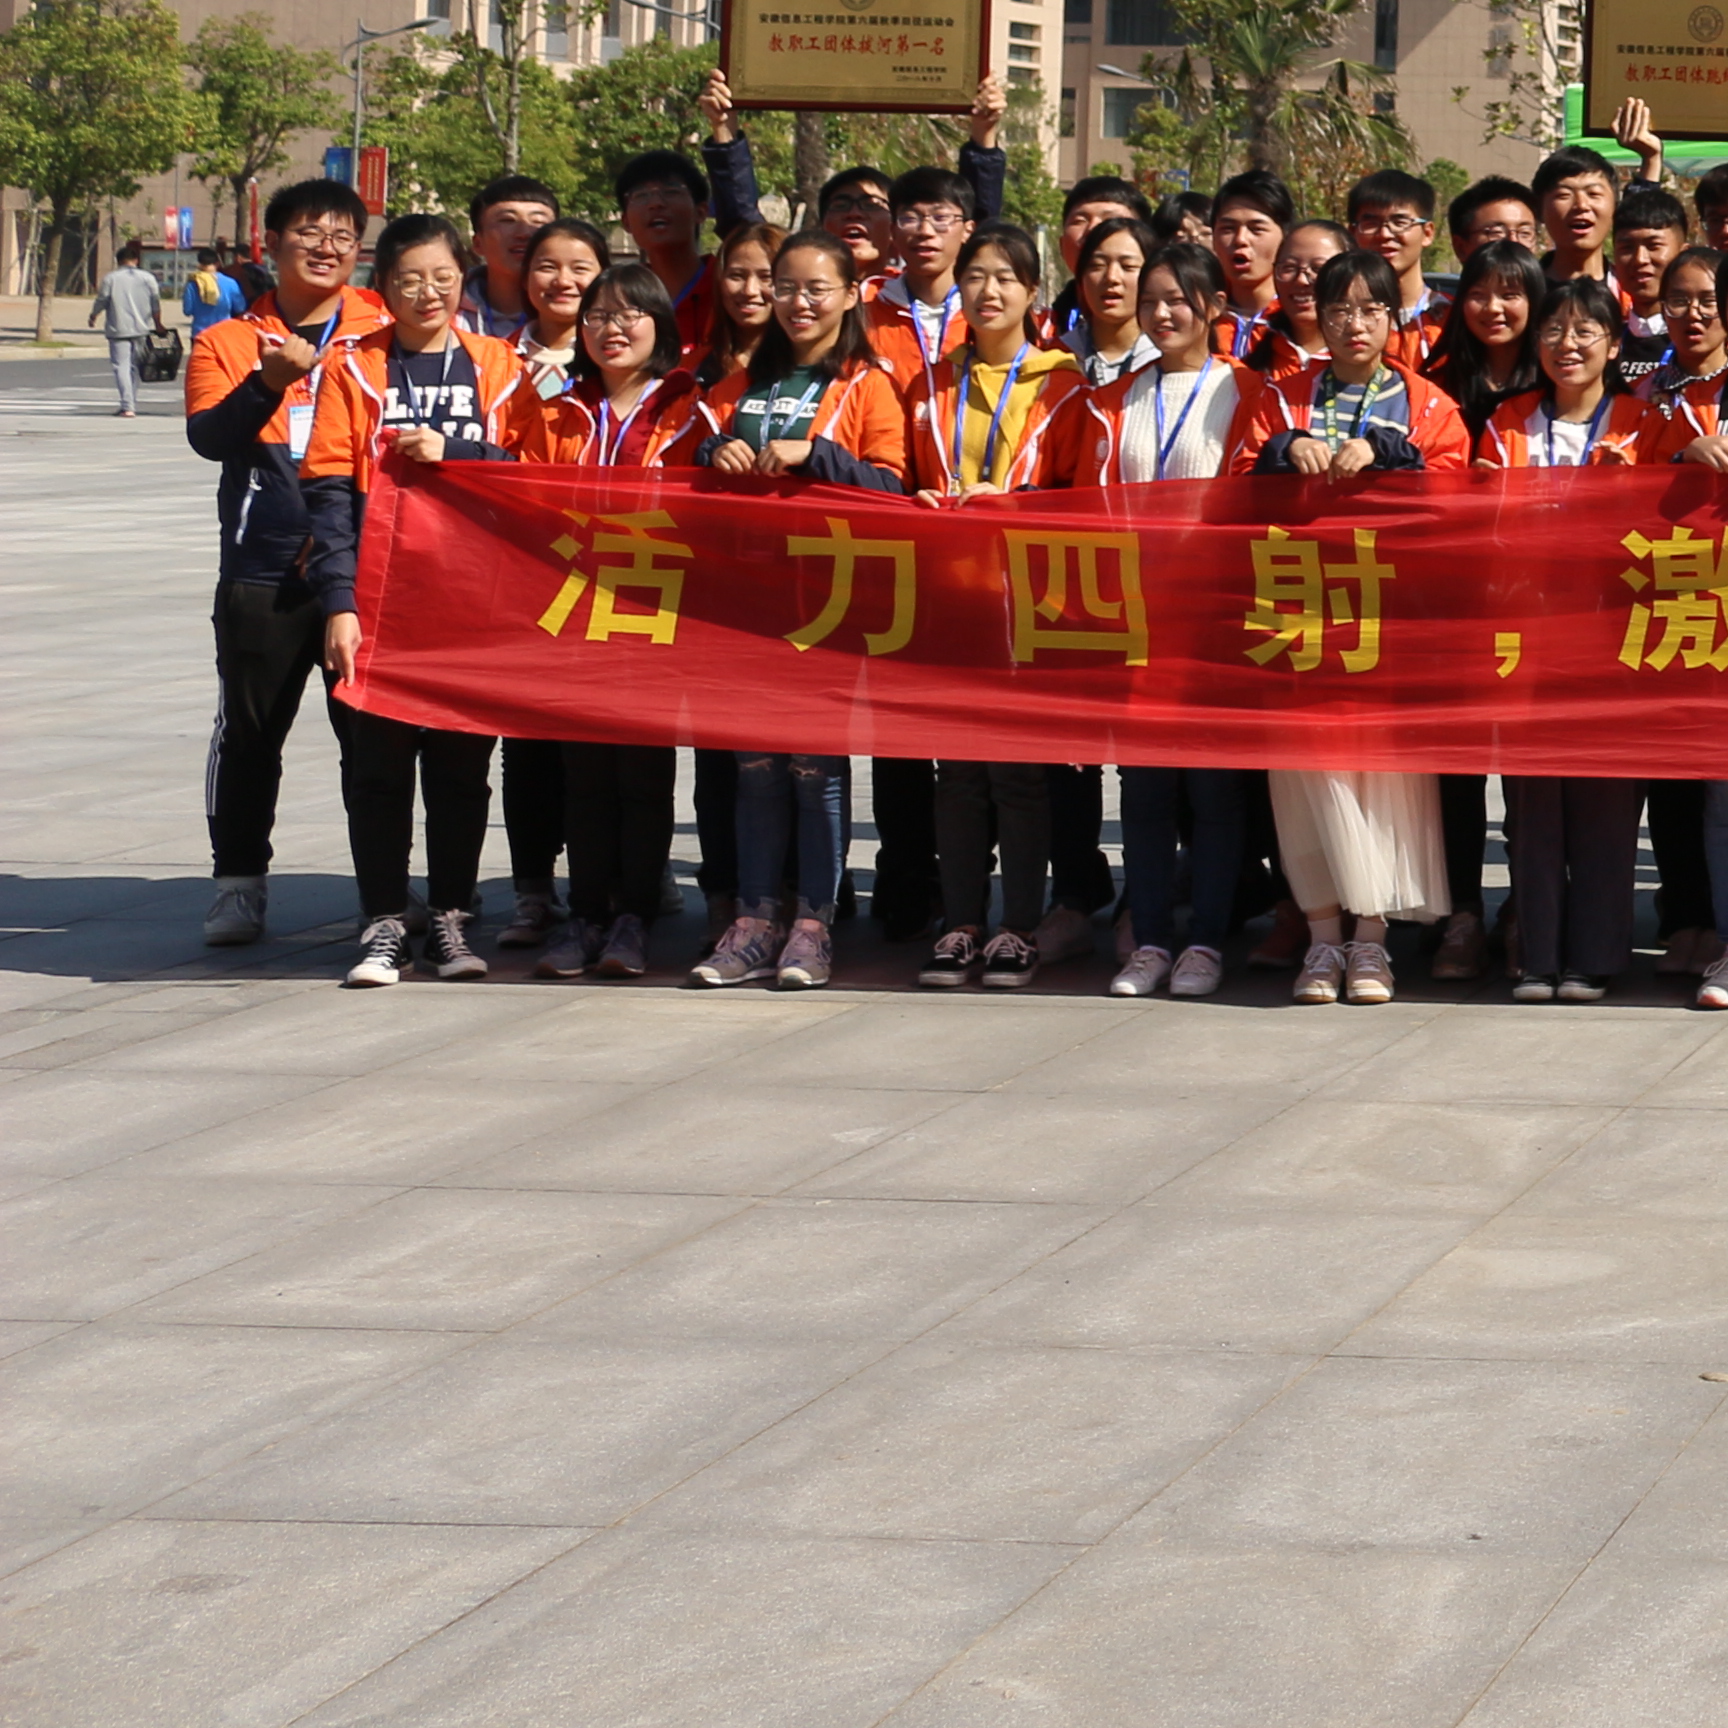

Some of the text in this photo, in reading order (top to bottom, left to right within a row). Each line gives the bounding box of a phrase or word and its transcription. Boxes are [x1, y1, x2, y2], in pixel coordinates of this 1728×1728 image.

[768, 34, 946, 57] 教职工团体拔河第一名
